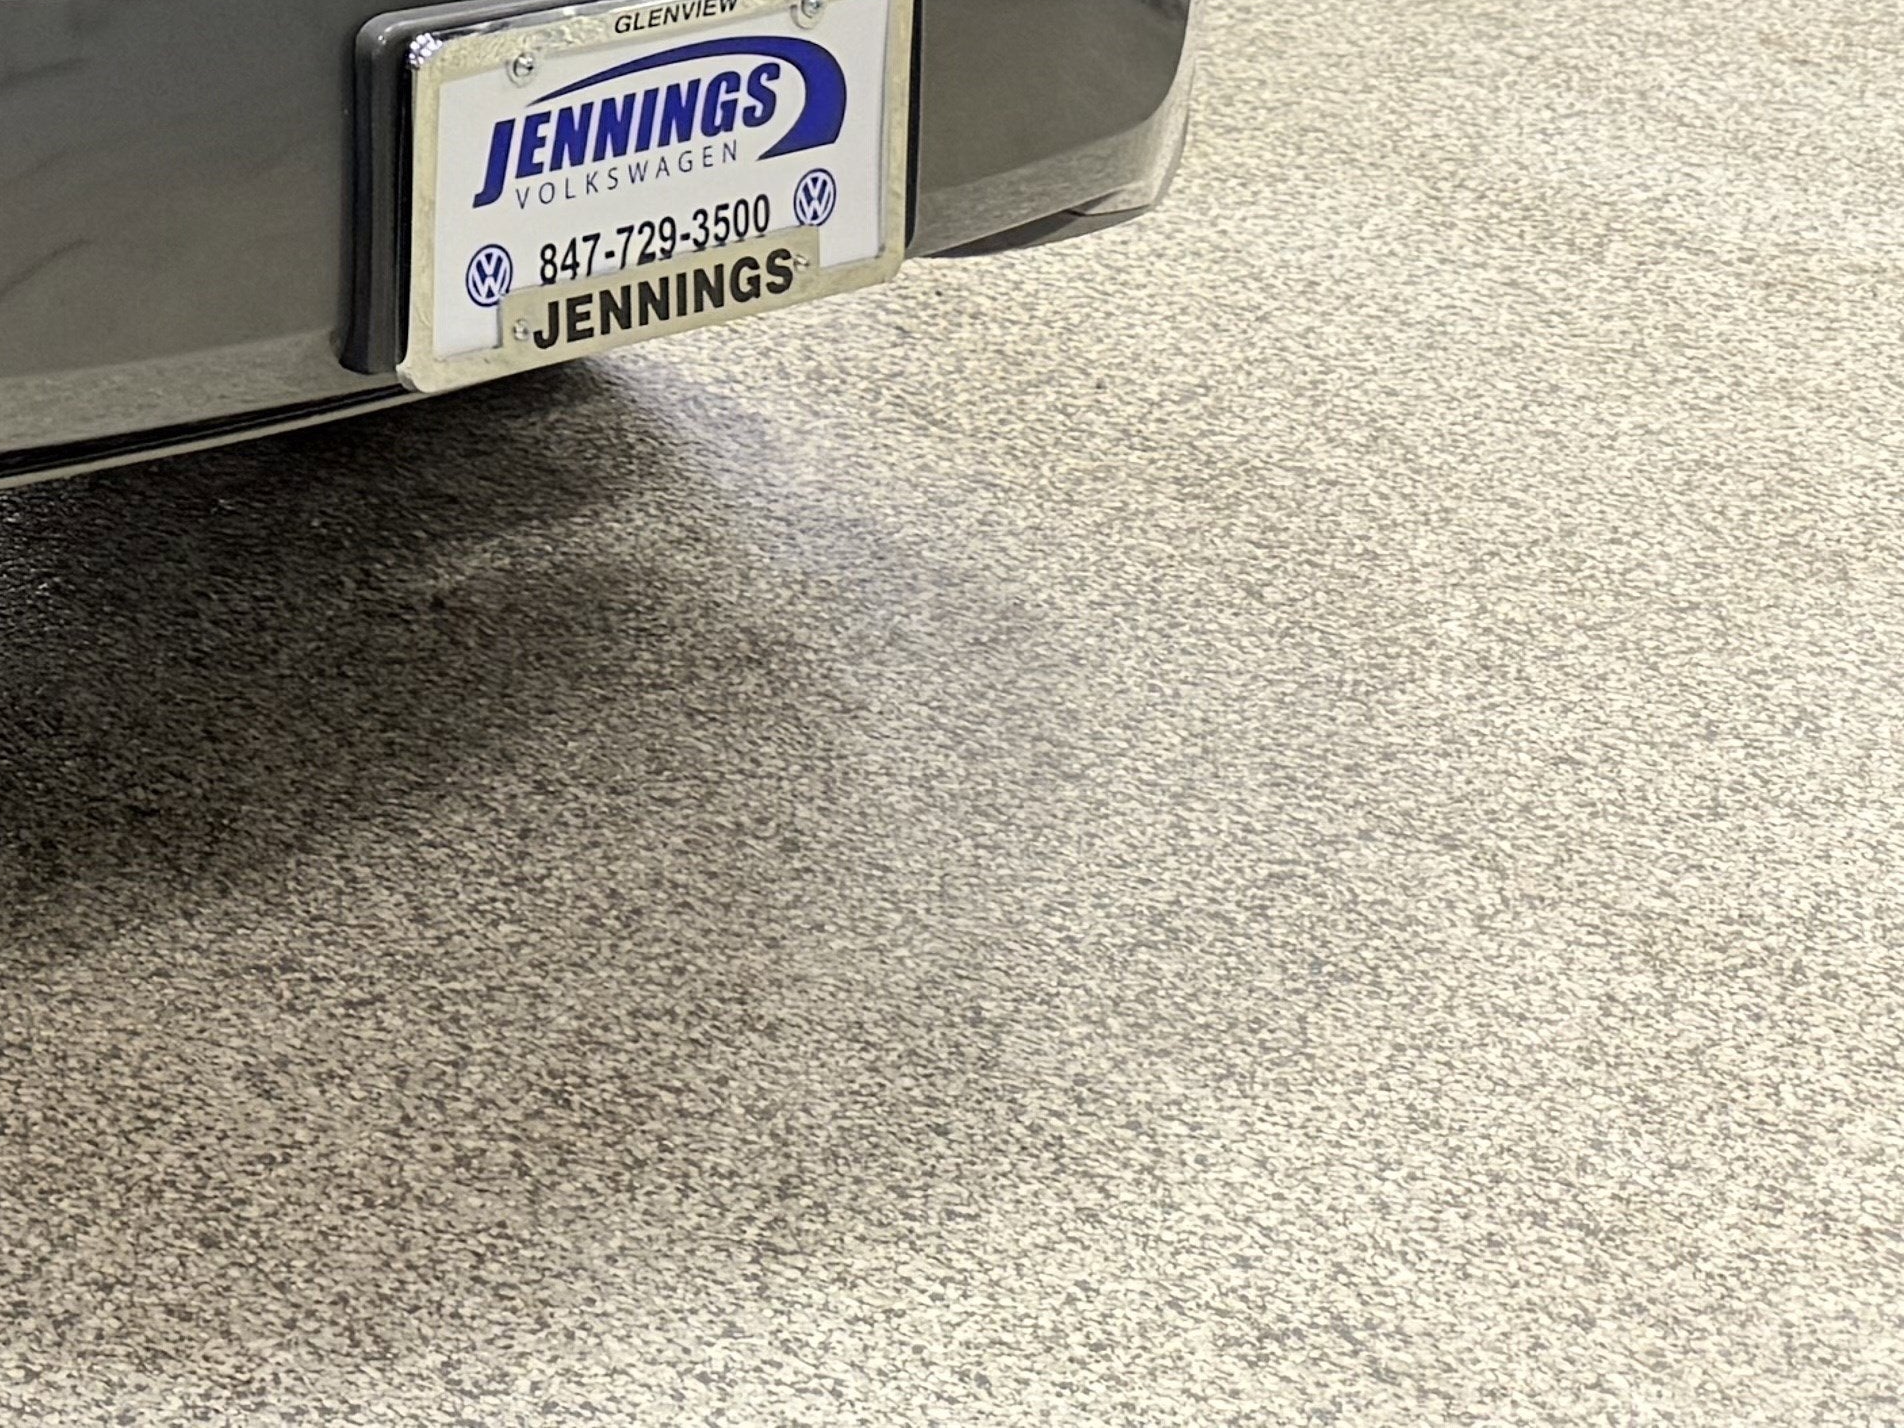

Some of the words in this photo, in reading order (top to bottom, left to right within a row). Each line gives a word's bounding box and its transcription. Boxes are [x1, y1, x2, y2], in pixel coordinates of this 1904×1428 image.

[471, 62, 781, 209] JENNINGS
[515, 139, 738, 210] VOLKSWAGEN
[539, 193, 771, 287] 847-729-3500
[532, 248, 794, 350] JENNINGS
